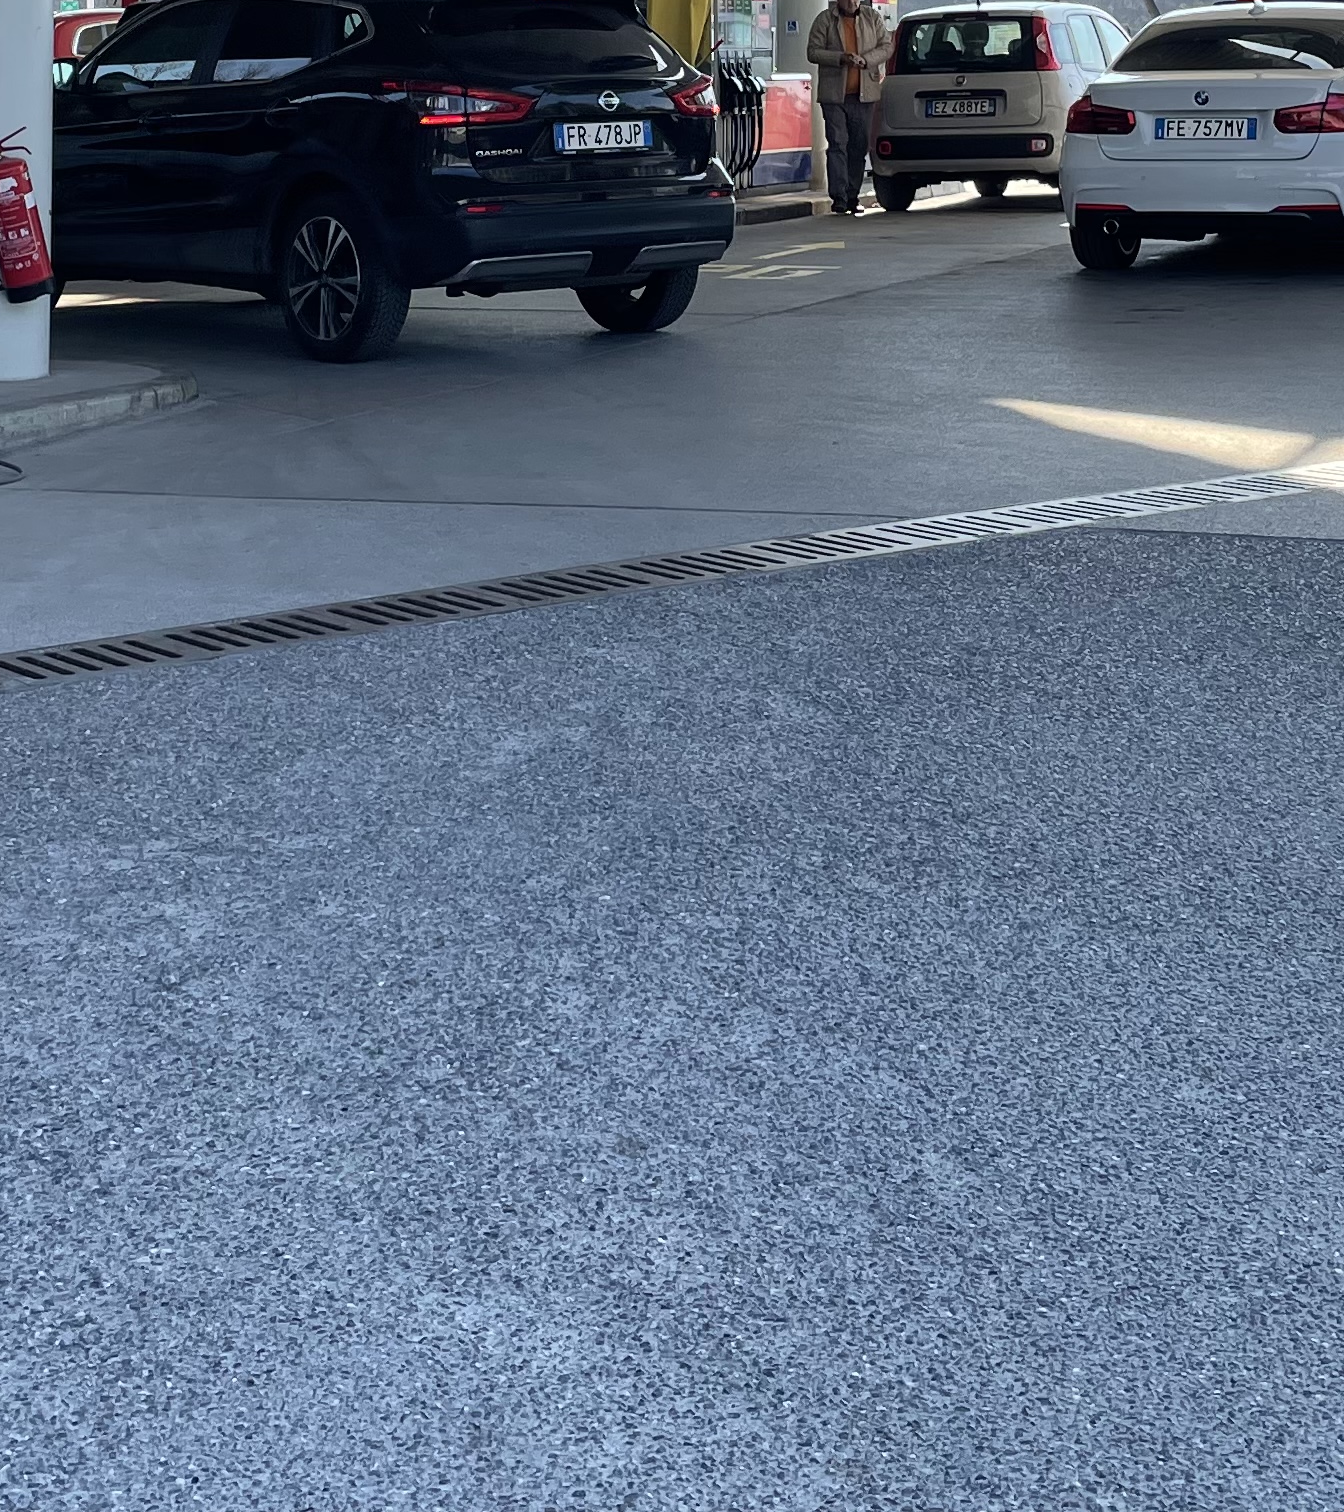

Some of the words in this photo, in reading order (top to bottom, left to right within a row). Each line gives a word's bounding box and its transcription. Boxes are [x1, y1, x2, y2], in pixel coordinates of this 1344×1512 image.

[934, 101, 948, 114] EZ
[566, 125, 588, 148] FR
[594, 123, 642, 146] 478JP
[1166, 120, 1186, 137] FE
[1192, 120, 1245, 137] 757MV
